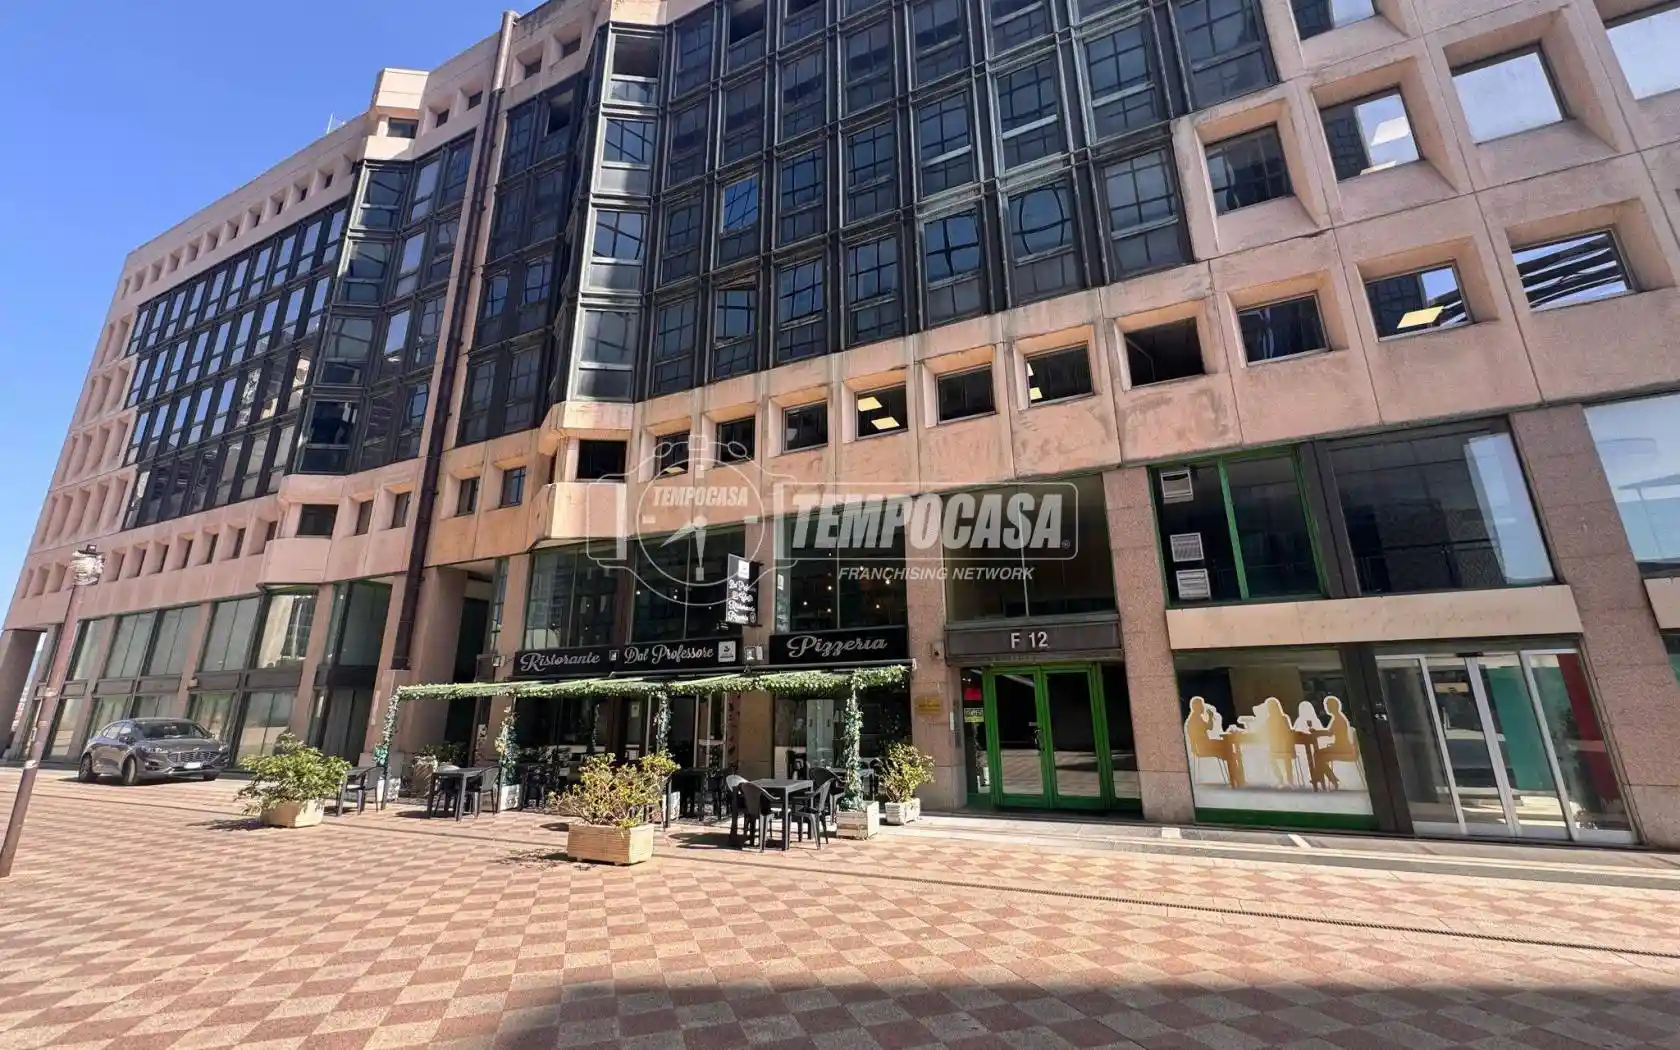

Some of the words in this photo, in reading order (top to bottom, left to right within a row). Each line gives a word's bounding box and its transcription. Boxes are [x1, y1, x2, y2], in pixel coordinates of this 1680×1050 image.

[786, 635, 888, 658] Pizzeria
[1010, 632, 1021, 649] F
[1028, 631, 1049, 648] 12
[520, 652, 600, 672] Ristorante
[623, 646, 649, 664] Dal
[651, 644, 714, 664] Professore
